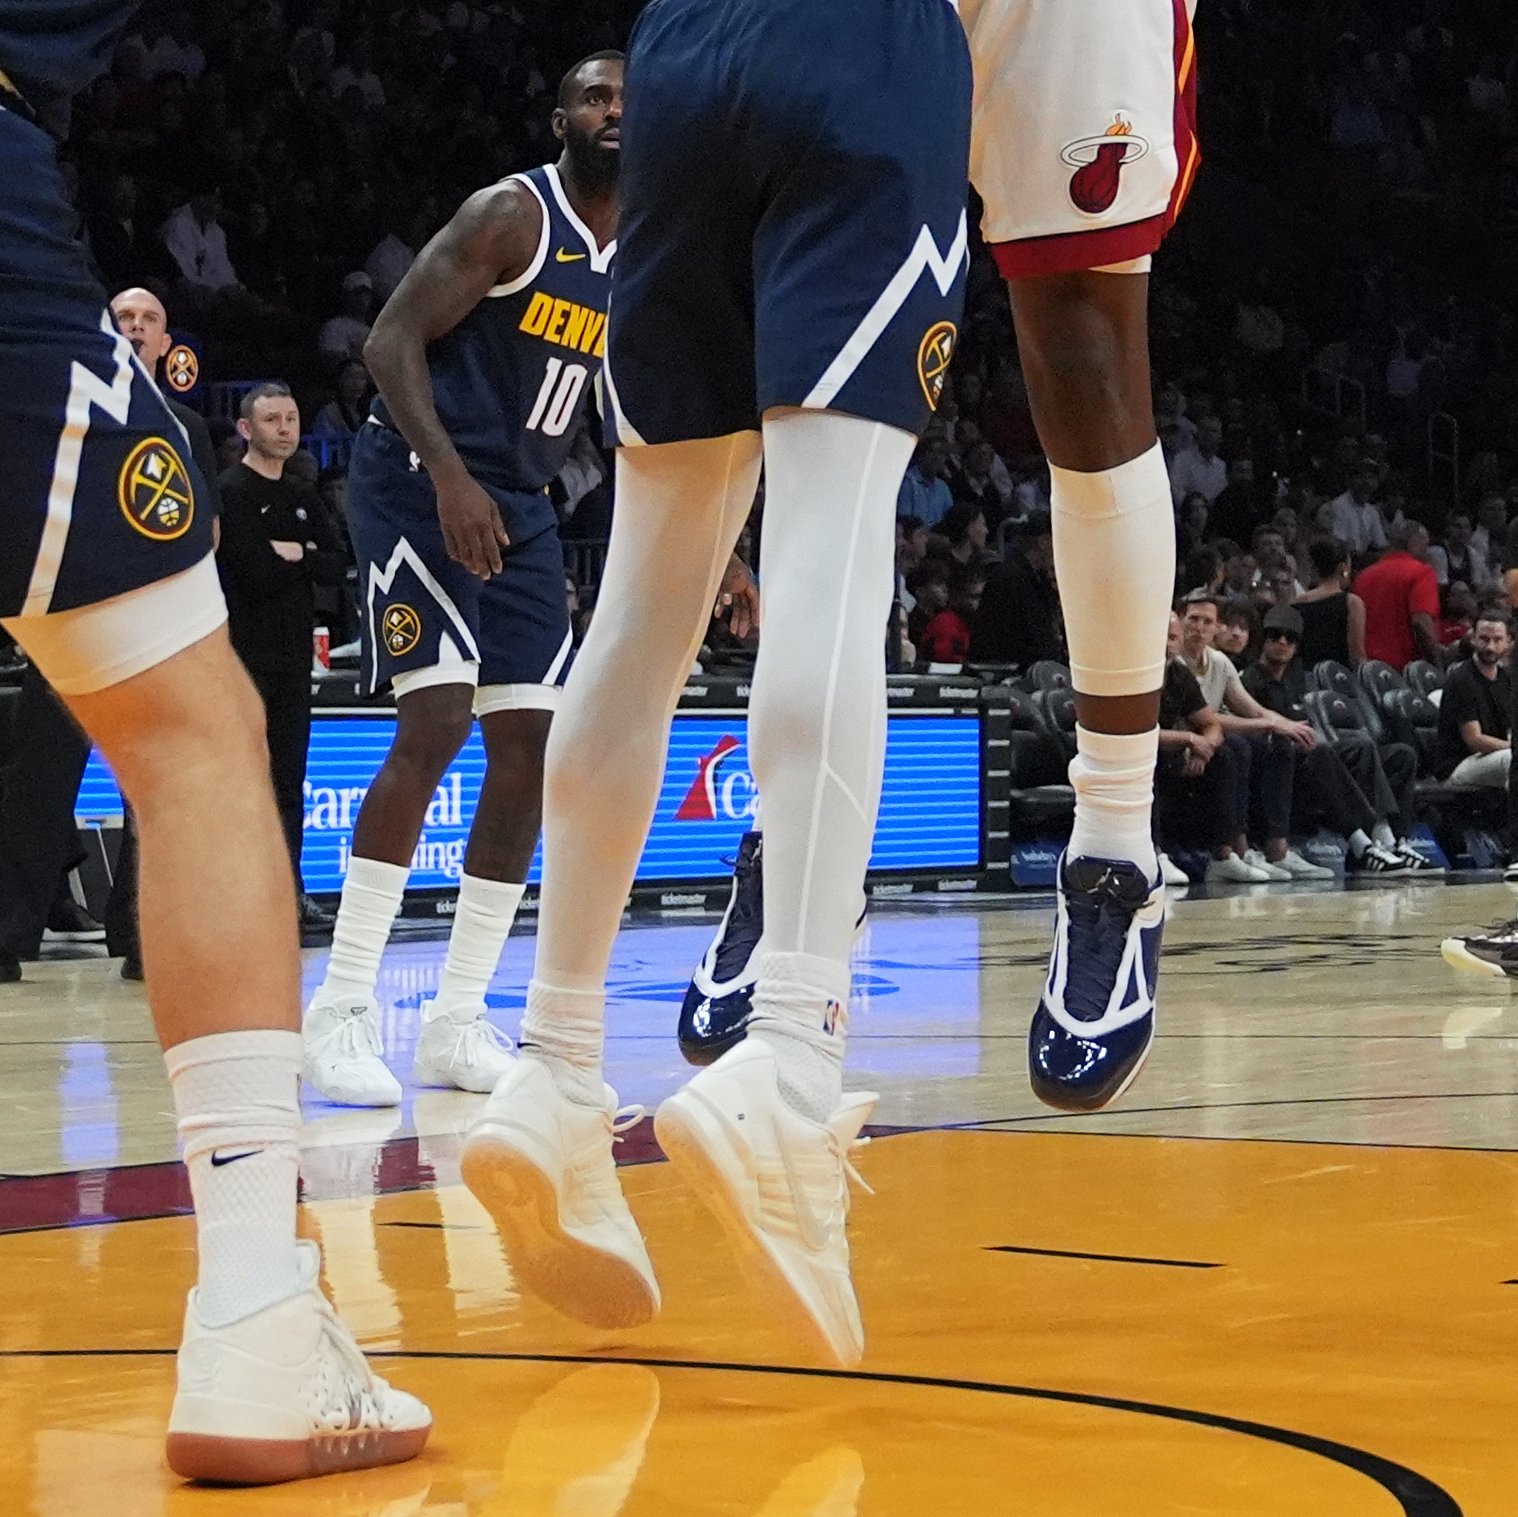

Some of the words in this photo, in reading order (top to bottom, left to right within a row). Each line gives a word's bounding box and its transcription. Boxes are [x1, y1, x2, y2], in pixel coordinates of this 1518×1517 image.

[518, 291, 608, 358] DENV
[525, 356, 589, 437] 10
[303, 772, 462, 831] Caral
